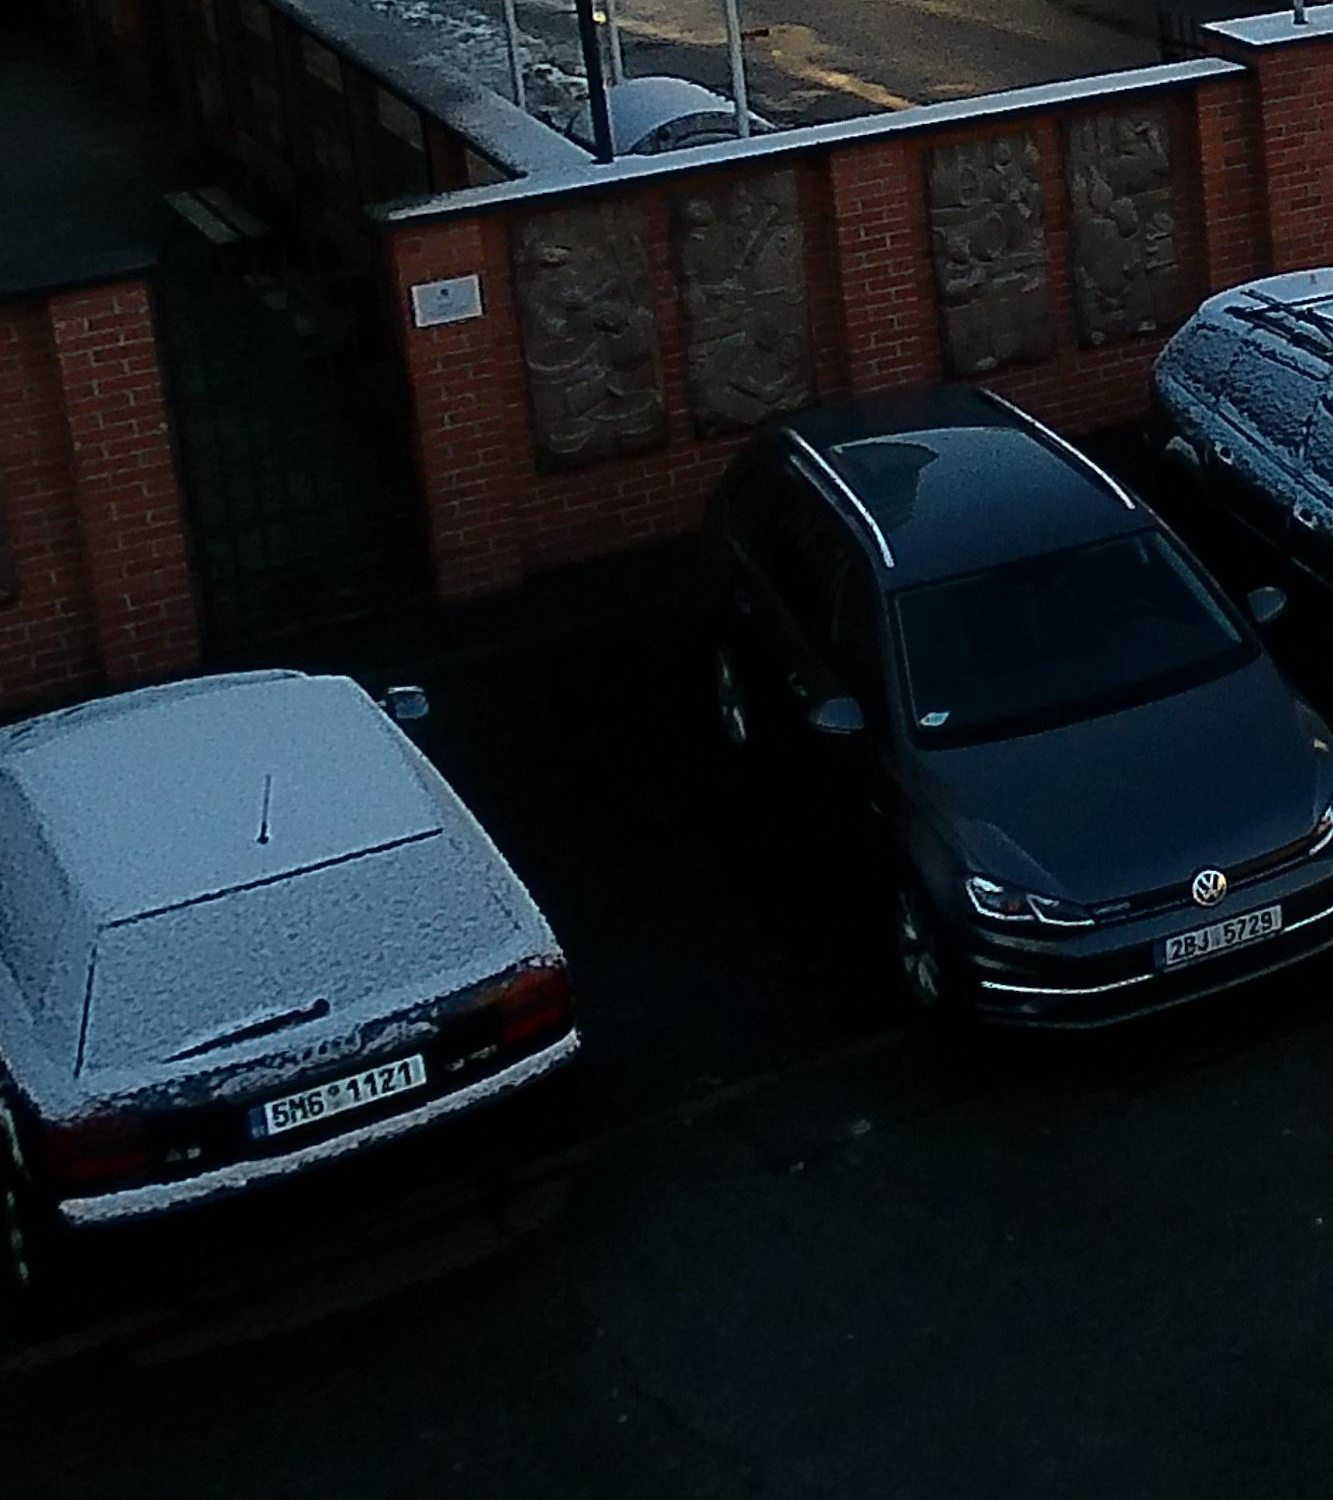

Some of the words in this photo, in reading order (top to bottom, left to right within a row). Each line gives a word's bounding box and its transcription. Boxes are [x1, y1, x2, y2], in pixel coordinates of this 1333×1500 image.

[1171, 932, 1209, 961] 2BJ
[1223, 911, 1272, 943] 5729
[271, 1090, 325, 1128] 5M6
[345, 1061, 412, 1102] 1121
